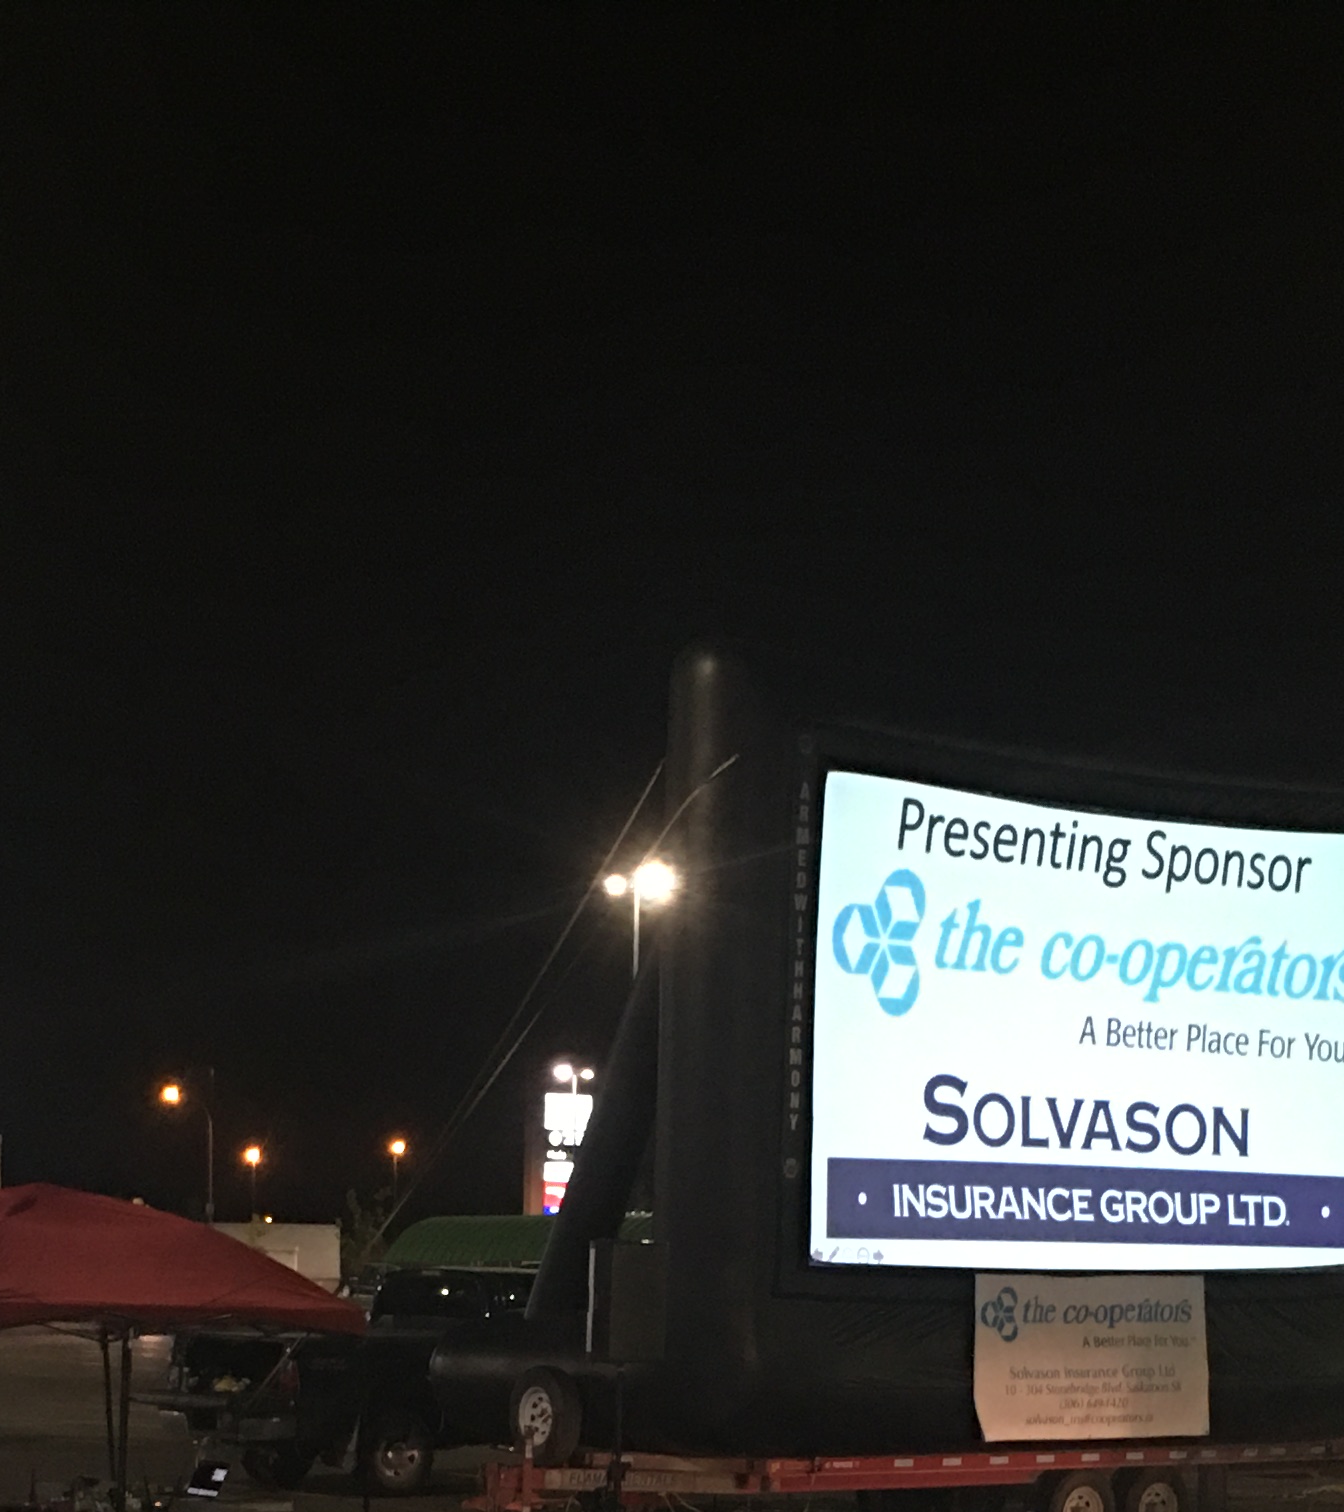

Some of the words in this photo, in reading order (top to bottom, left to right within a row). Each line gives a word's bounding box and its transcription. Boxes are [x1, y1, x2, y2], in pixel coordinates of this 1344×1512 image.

[897, 798, 1132, 888] Presenting
[1142, 830, 1312, 893] Sponsor
[935, 899, 1024, 975] the
[1079, 1016, 1096, 1045] A
[1106, 1018, 1178, 1050] Better
[1187, 1024, 1249, 1056] Place
[1258, 1029, 1295, 1058] For
[923, 1074, 1249, 1157] SOLVASON
[893, 1184, 1094, 1221] INSURANCE
[1100, 1189, 1220, 1225] GROUP
[1228, 1194, 1289, 1226] LTD.
[1023, 1296, 1056, 1324] the
[1063, 1298, 1191, 1328] co-operators
[1083, 1337, 1090, 1348] A
[1094, 1337, 1125, 1348] Better
[1009, 1366, 1060, 1379] Solvason
[1065, 1366, 1118, 1379] Insurance
[1122, 1364, 1156, 1381] Group
